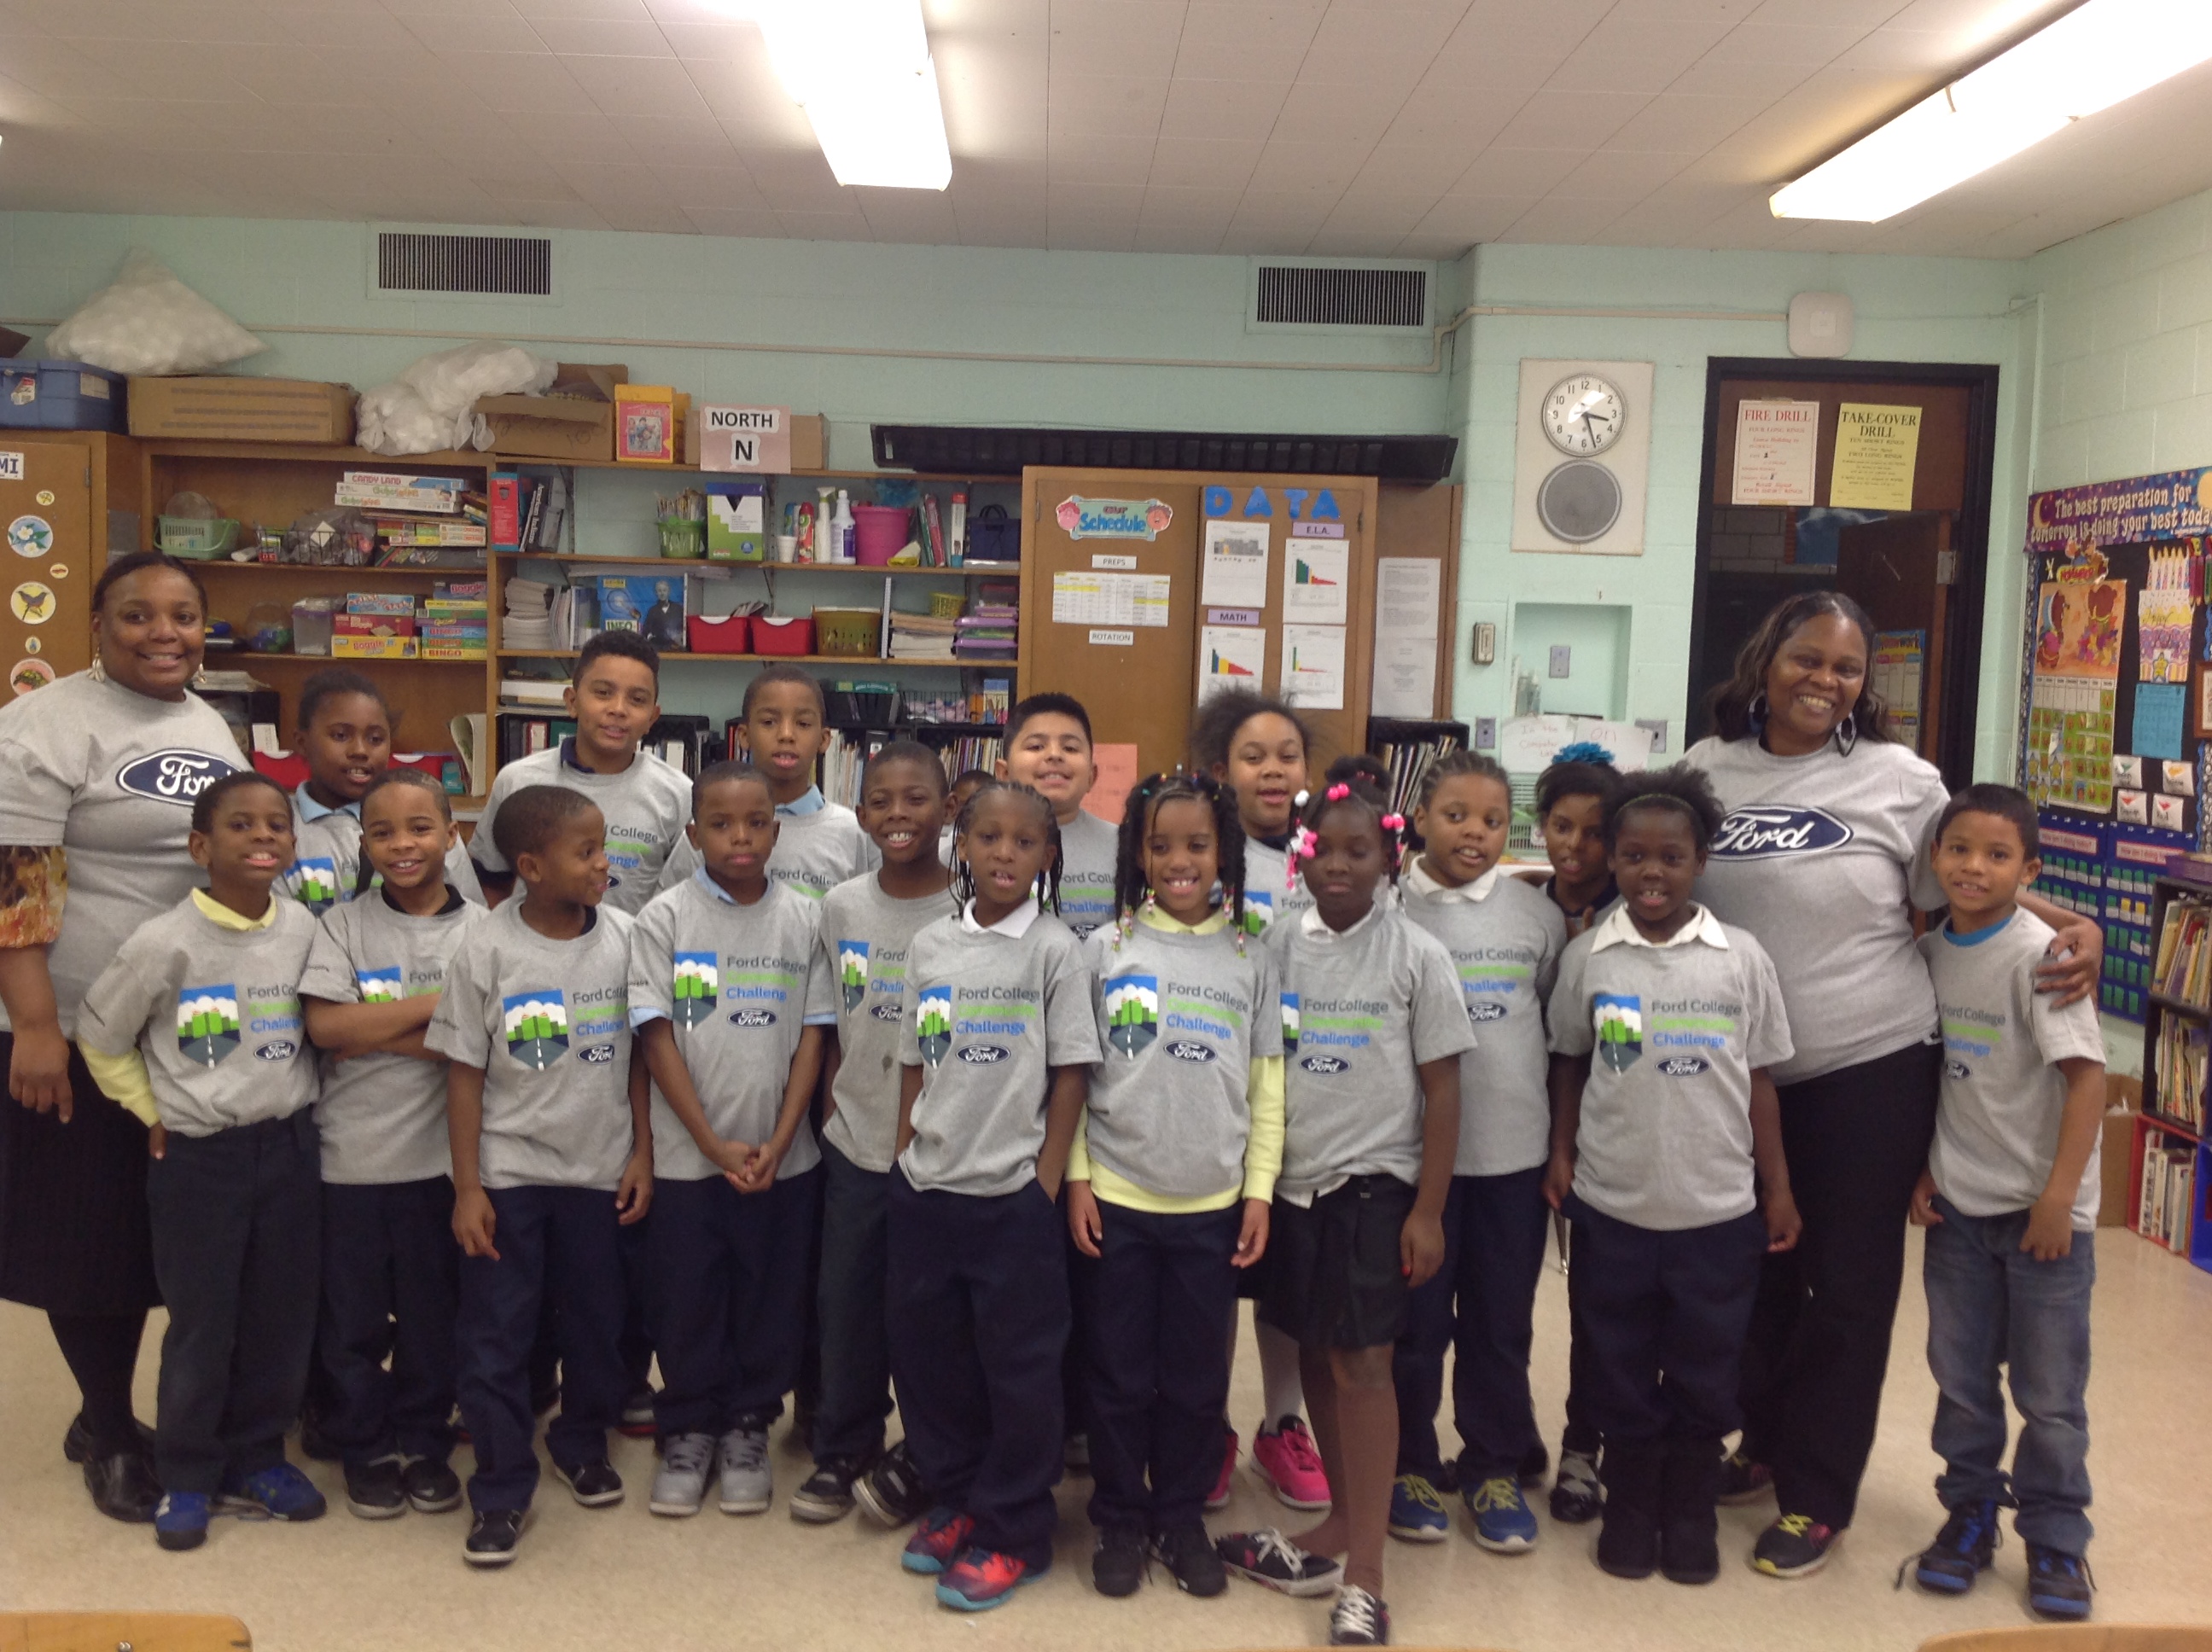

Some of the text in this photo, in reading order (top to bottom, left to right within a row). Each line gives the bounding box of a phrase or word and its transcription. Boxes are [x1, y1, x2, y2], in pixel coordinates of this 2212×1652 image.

[1568, 384, 1575, 393] 11
[1581, 381, 1590, 390] 12
[1556, 395, 1564, 404] 10
[712, 411, 772, 428] NORTH
[1745, 410, 1811, 422] FIRE DRILL
[1842, 411, 1916, 426] TAKE-COVER
[1860, 426, 1895, 438] DRILL
[736, 440, 752, 461] N
[352, 474, 402, 486] CANDY LAND
[1205, 485, 1341, 520] DATA
[2055, 483, 2192, 519] The best preparation for
[1080, 512, 1146, 532] Schedule
[2031, 523, 2078, 543] tomorrow
[2091, 515, 2118, 538] doing
[2121, 513, 2148, 537] your
[2151, 507, 2177, 530] best
[2181, 506, 2212, 526] toda
[1307, 526, 1330, 535] E.L.A.
[1103, 557, 1126, 567] PREPS
[1220, 613, 1247, 622] MATH
[429, 638, 462, 647] BINGO
[1091, 632, 1131, 642] ROTATION
[428, 649, 462, 657] BINGO
[156, 756, 231, 795] For
[610, 825, 658, 843] College
[1711, 811, 1815, 852] Ford
[771, 869, 800, 884] Ford
[1062, 872, 1086, 884] ord
[727, 956, 760, 969] Ford
[876, 947, 906, 962] Ford
[410, 969, 443, 984] Ford
[247, 984, 280, 998] Ford
[573, 988, 603, 1004] Ford
[958, 986, 990, 1001] Ford
[1167, 982, 1201, 998] Ford
[1204, 987, 1249, 1014] College
[1304, 998, 1389, 1015] Ford College
[1652, 998, 1743, 1016] Ford College
[738, 1009, 770, 1026] Ford
[957, 1021, 1026, 1037] Challenge
[1166, 1013, 1232, 1040] Challenge
[1301, 1030, 1371, 1049] Challenge
[1653, 1032, 1726, 1050] Challenge
[588, 1045, 614, 1062] Ford
[965, 1045, 999, 1062] Ford
[1174, 1043, 1208, 1061] Ford
[1307, 1057, 1341, 1073] Ford
[1667, 1057, 1700, 1075] Ford
